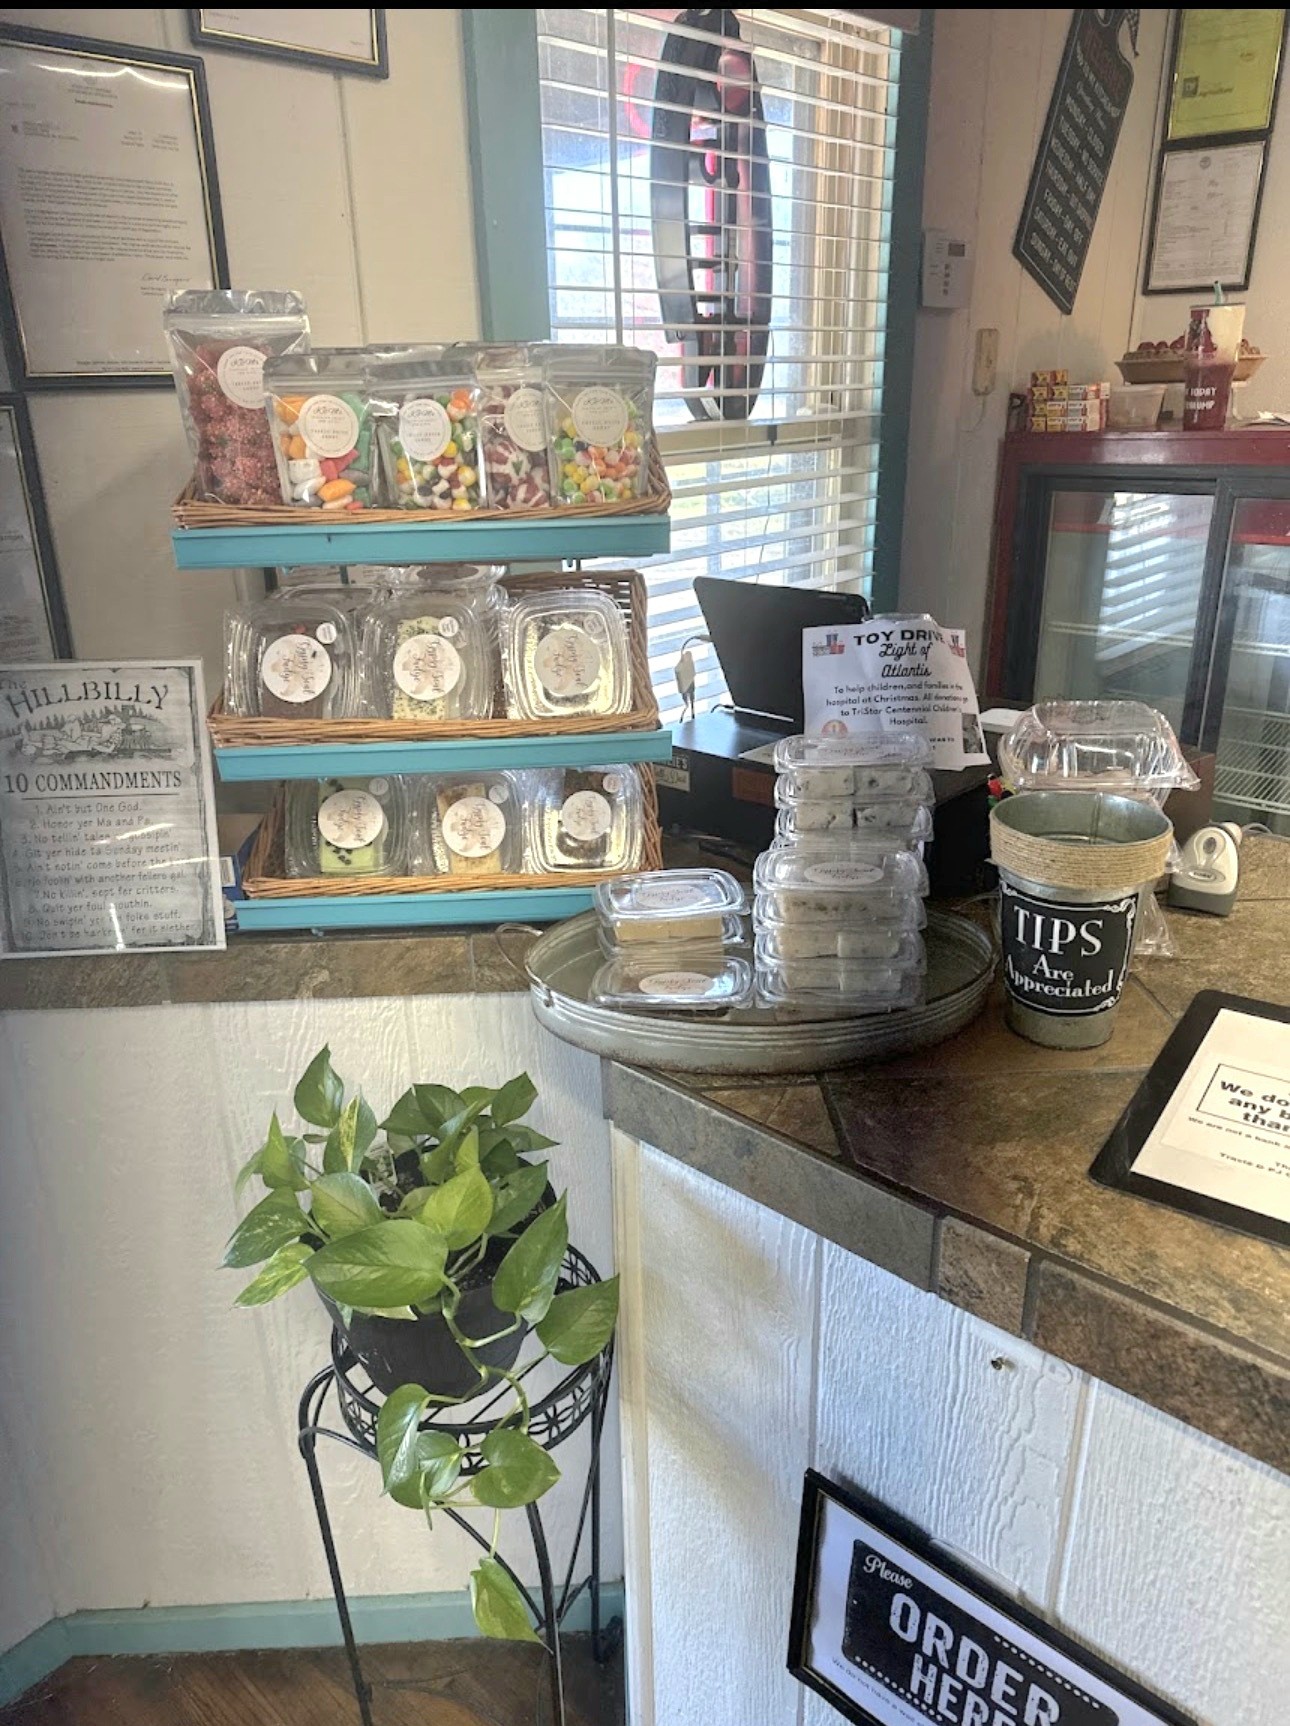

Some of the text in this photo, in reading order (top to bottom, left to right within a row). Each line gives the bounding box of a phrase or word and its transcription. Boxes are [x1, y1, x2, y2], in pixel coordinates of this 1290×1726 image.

[853, 630, 895, 646] TOY
[879, 641, 934, 661] Light of
[882, 663, 932, 678] Atlantis
[834, 686, 844, 694] To
[846, 683, 865, 694] help
[6, 680, 169, 719] HILLBILLY
[826, 694, 860, 706] hospital
[861, 696, 872, 704] at
[840, 708, 851, 717] to
[885, 704, 931, 714] Centennial
[5, 771, 182, 793] 10 COMMANDMENTS
[75, 803, 92, 814] but
[96, 802, 115, 813] One
[118, 801, 142, 812] God.
[97, 817, 112, 827] Ma
[115, 818, 134, 826] and
[34, 833, 49, 843] No
[115, 857, 147, 868] before
[74, 874, 95, 884] with
[98, 872, 137, 883] another
[1014, 906, 1103, 957] TIPS
[1032, 954, 1074, 981] Are
[1006, 954, 1114, 998] Appreciated
[1221, 1081, 1254, 1097] We
[1228, 1098, 1271, 1115] any
[863, 1554, 913, 1589] Please
[889, 1592, 1060, 1726] ORDER
